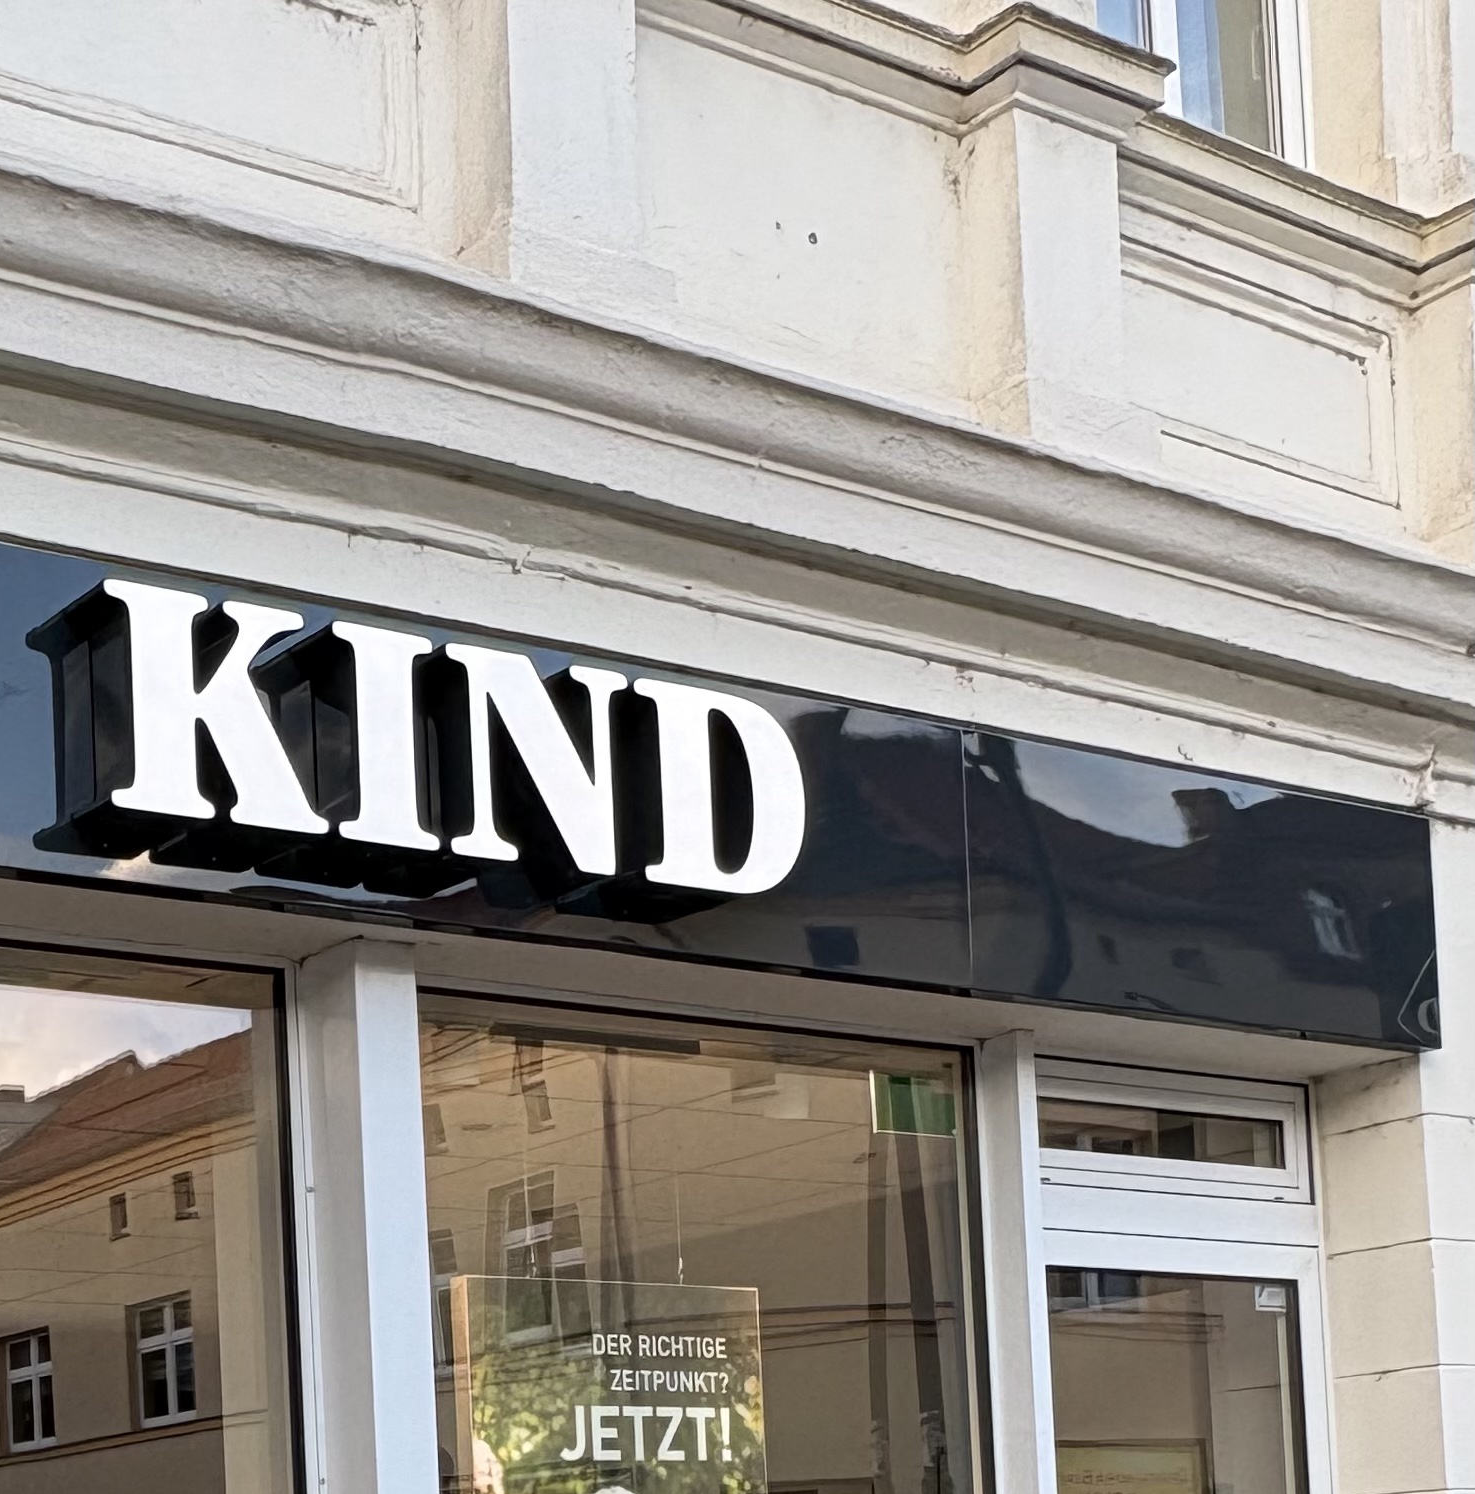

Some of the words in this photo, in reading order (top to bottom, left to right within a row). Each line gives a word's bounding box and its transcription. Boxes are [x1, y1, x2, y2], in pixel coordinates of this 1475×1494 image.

[103, 578, 806, 895] KIND
[593, 1333, 632, 1357] DER
[637, 1335, 728, 1359] RICHTIGE
[610, 1368, 730, 1394] ZEITPUNKT?
[560, 1405, 733, 1462] JETZT!
